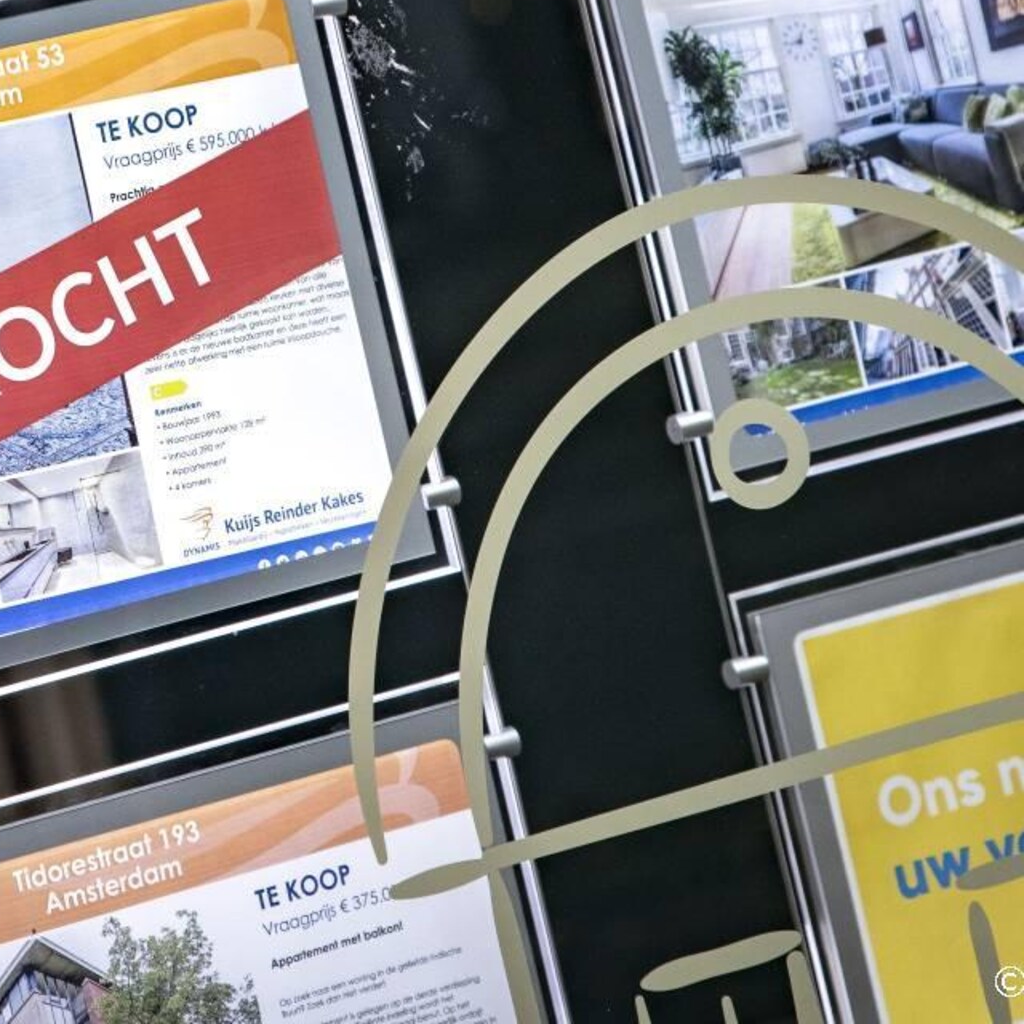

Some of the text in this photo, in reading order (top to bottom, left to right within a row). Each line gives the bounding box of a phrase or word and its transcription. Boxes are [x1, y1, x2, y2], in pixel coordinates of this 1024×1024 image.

[36, 43, 66, 70] 53
[95, 103, 198, 144] TE KOOP
[102, 143, 182, 170] Vraagprijs
[224, 514, 260, 534] Kuijs
[263, 501, 318, 525] Reinder
[320, 490, 365, 512] Kakes
[183, 541, 221, 558] DYNAMIS
[878, 768, 986, 827] Ons
[12, 820, 201, 893] Tidorestraat 193
[894, 831, 1024, 899] uw v
[46, 859, 183, 915] Amsterdam
[254, 864, 350, 910] TE KOOP
[262, 904, 337, 936] Vraagprijs
[353, 886, 392, 911] 375.0
[271, 921, 403, 969] Appartement met balkon!
